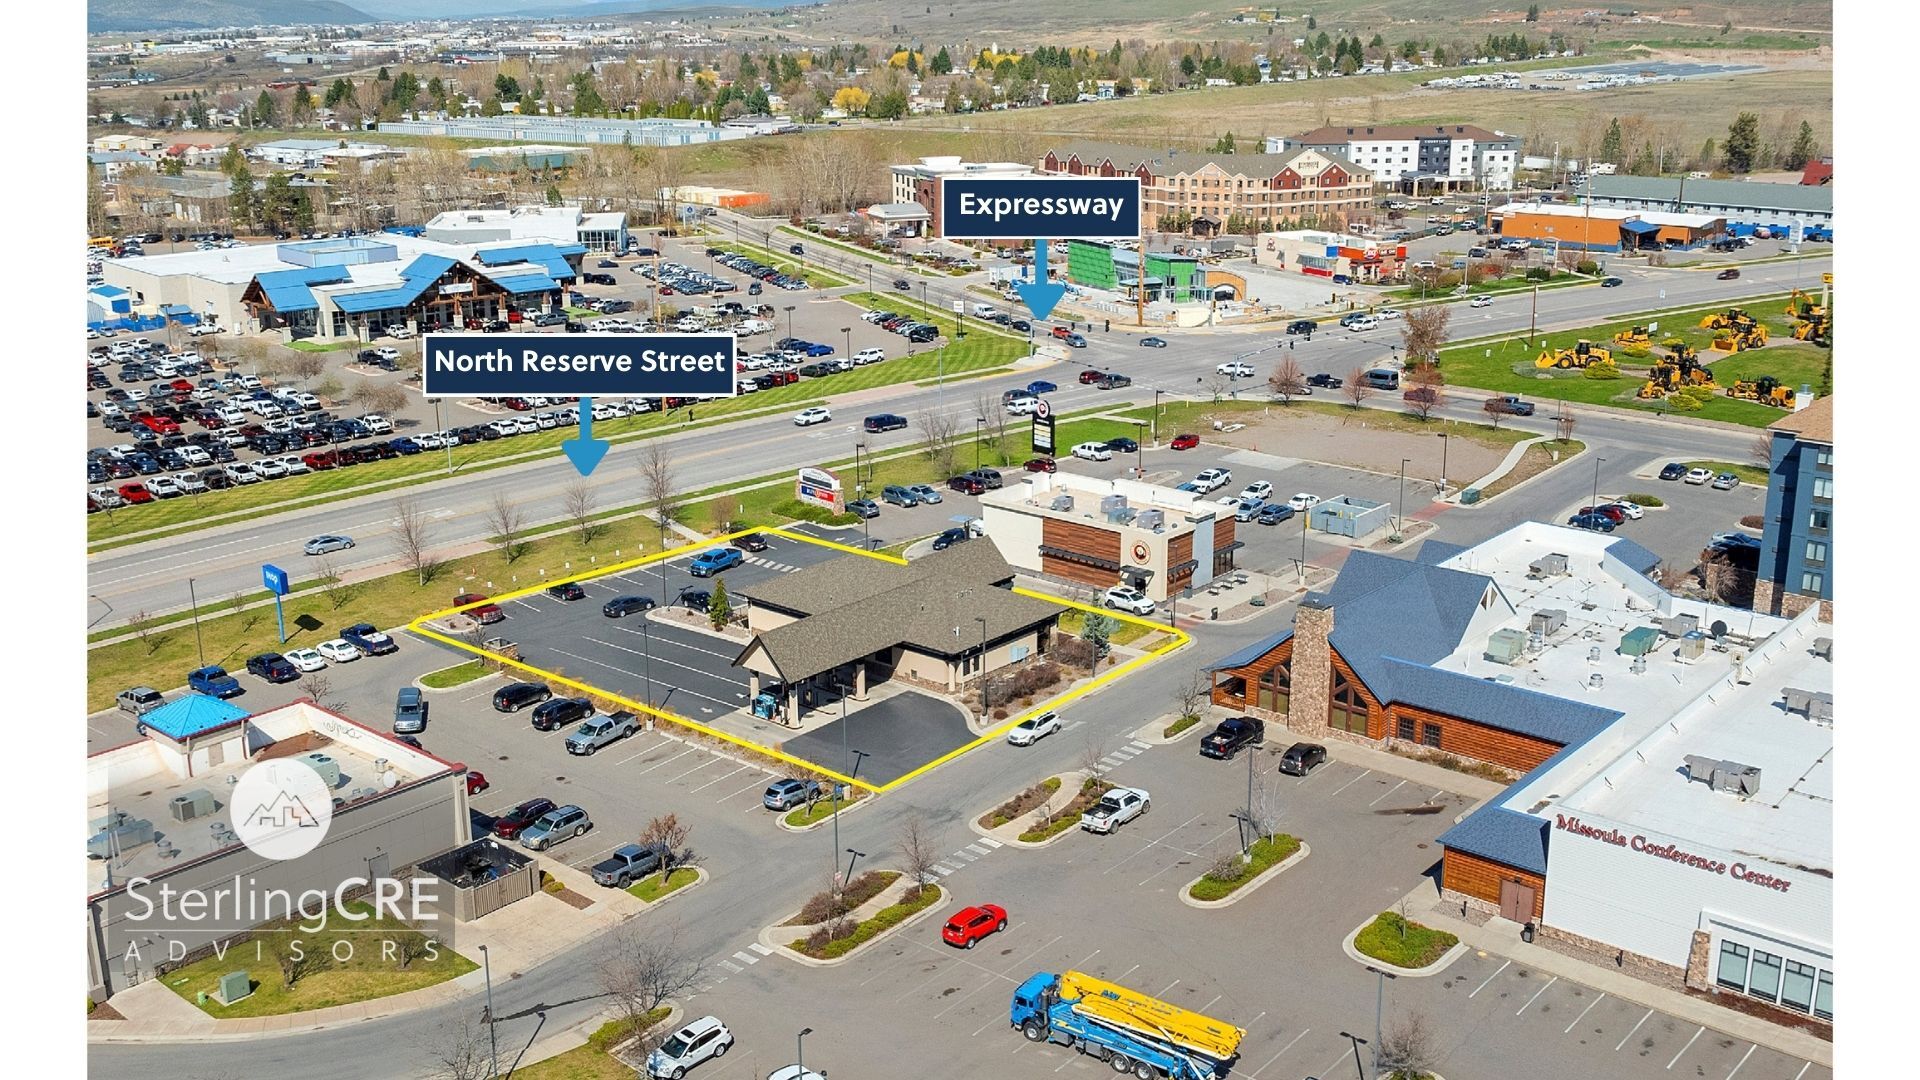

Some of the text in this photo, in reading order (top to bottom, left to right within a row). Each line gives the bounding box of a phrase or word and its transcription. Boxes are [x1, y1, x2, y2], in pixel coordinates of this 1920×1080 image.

[1555, 813, 1792, 893] Missoula Conference Center
